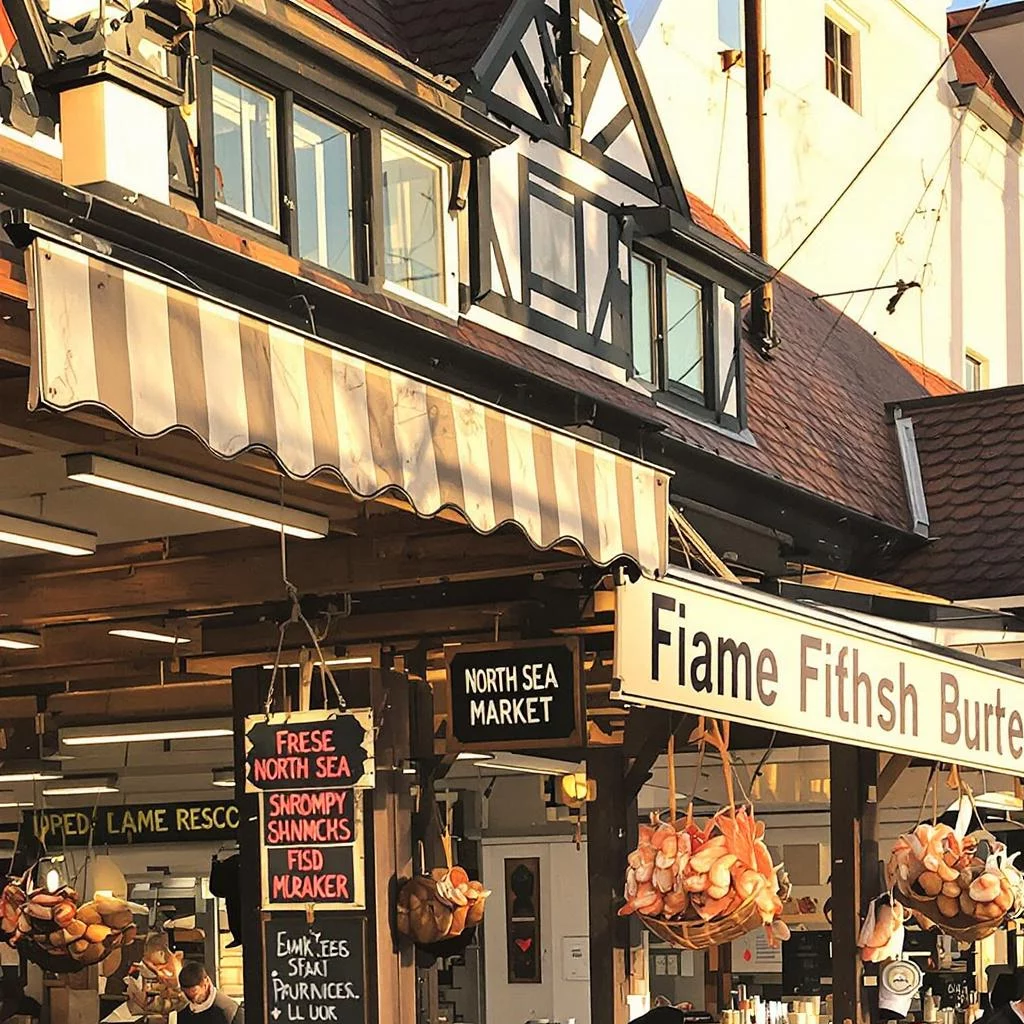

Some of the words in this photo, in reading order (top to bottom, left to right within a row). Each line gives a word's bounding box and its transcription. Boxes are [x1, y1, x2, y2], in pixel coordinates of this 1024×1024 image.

[464, 665, 518, 694] NORTH
[521, 662, 559, 692] SEA
[469, 695, 554, 727] MARKET
[275, 729, 336, 755] FRESE
[253, 756, 309, 782] NORTH
[315, 755, 352, 778] SEA
[106, 809, 169, 836] LAME
